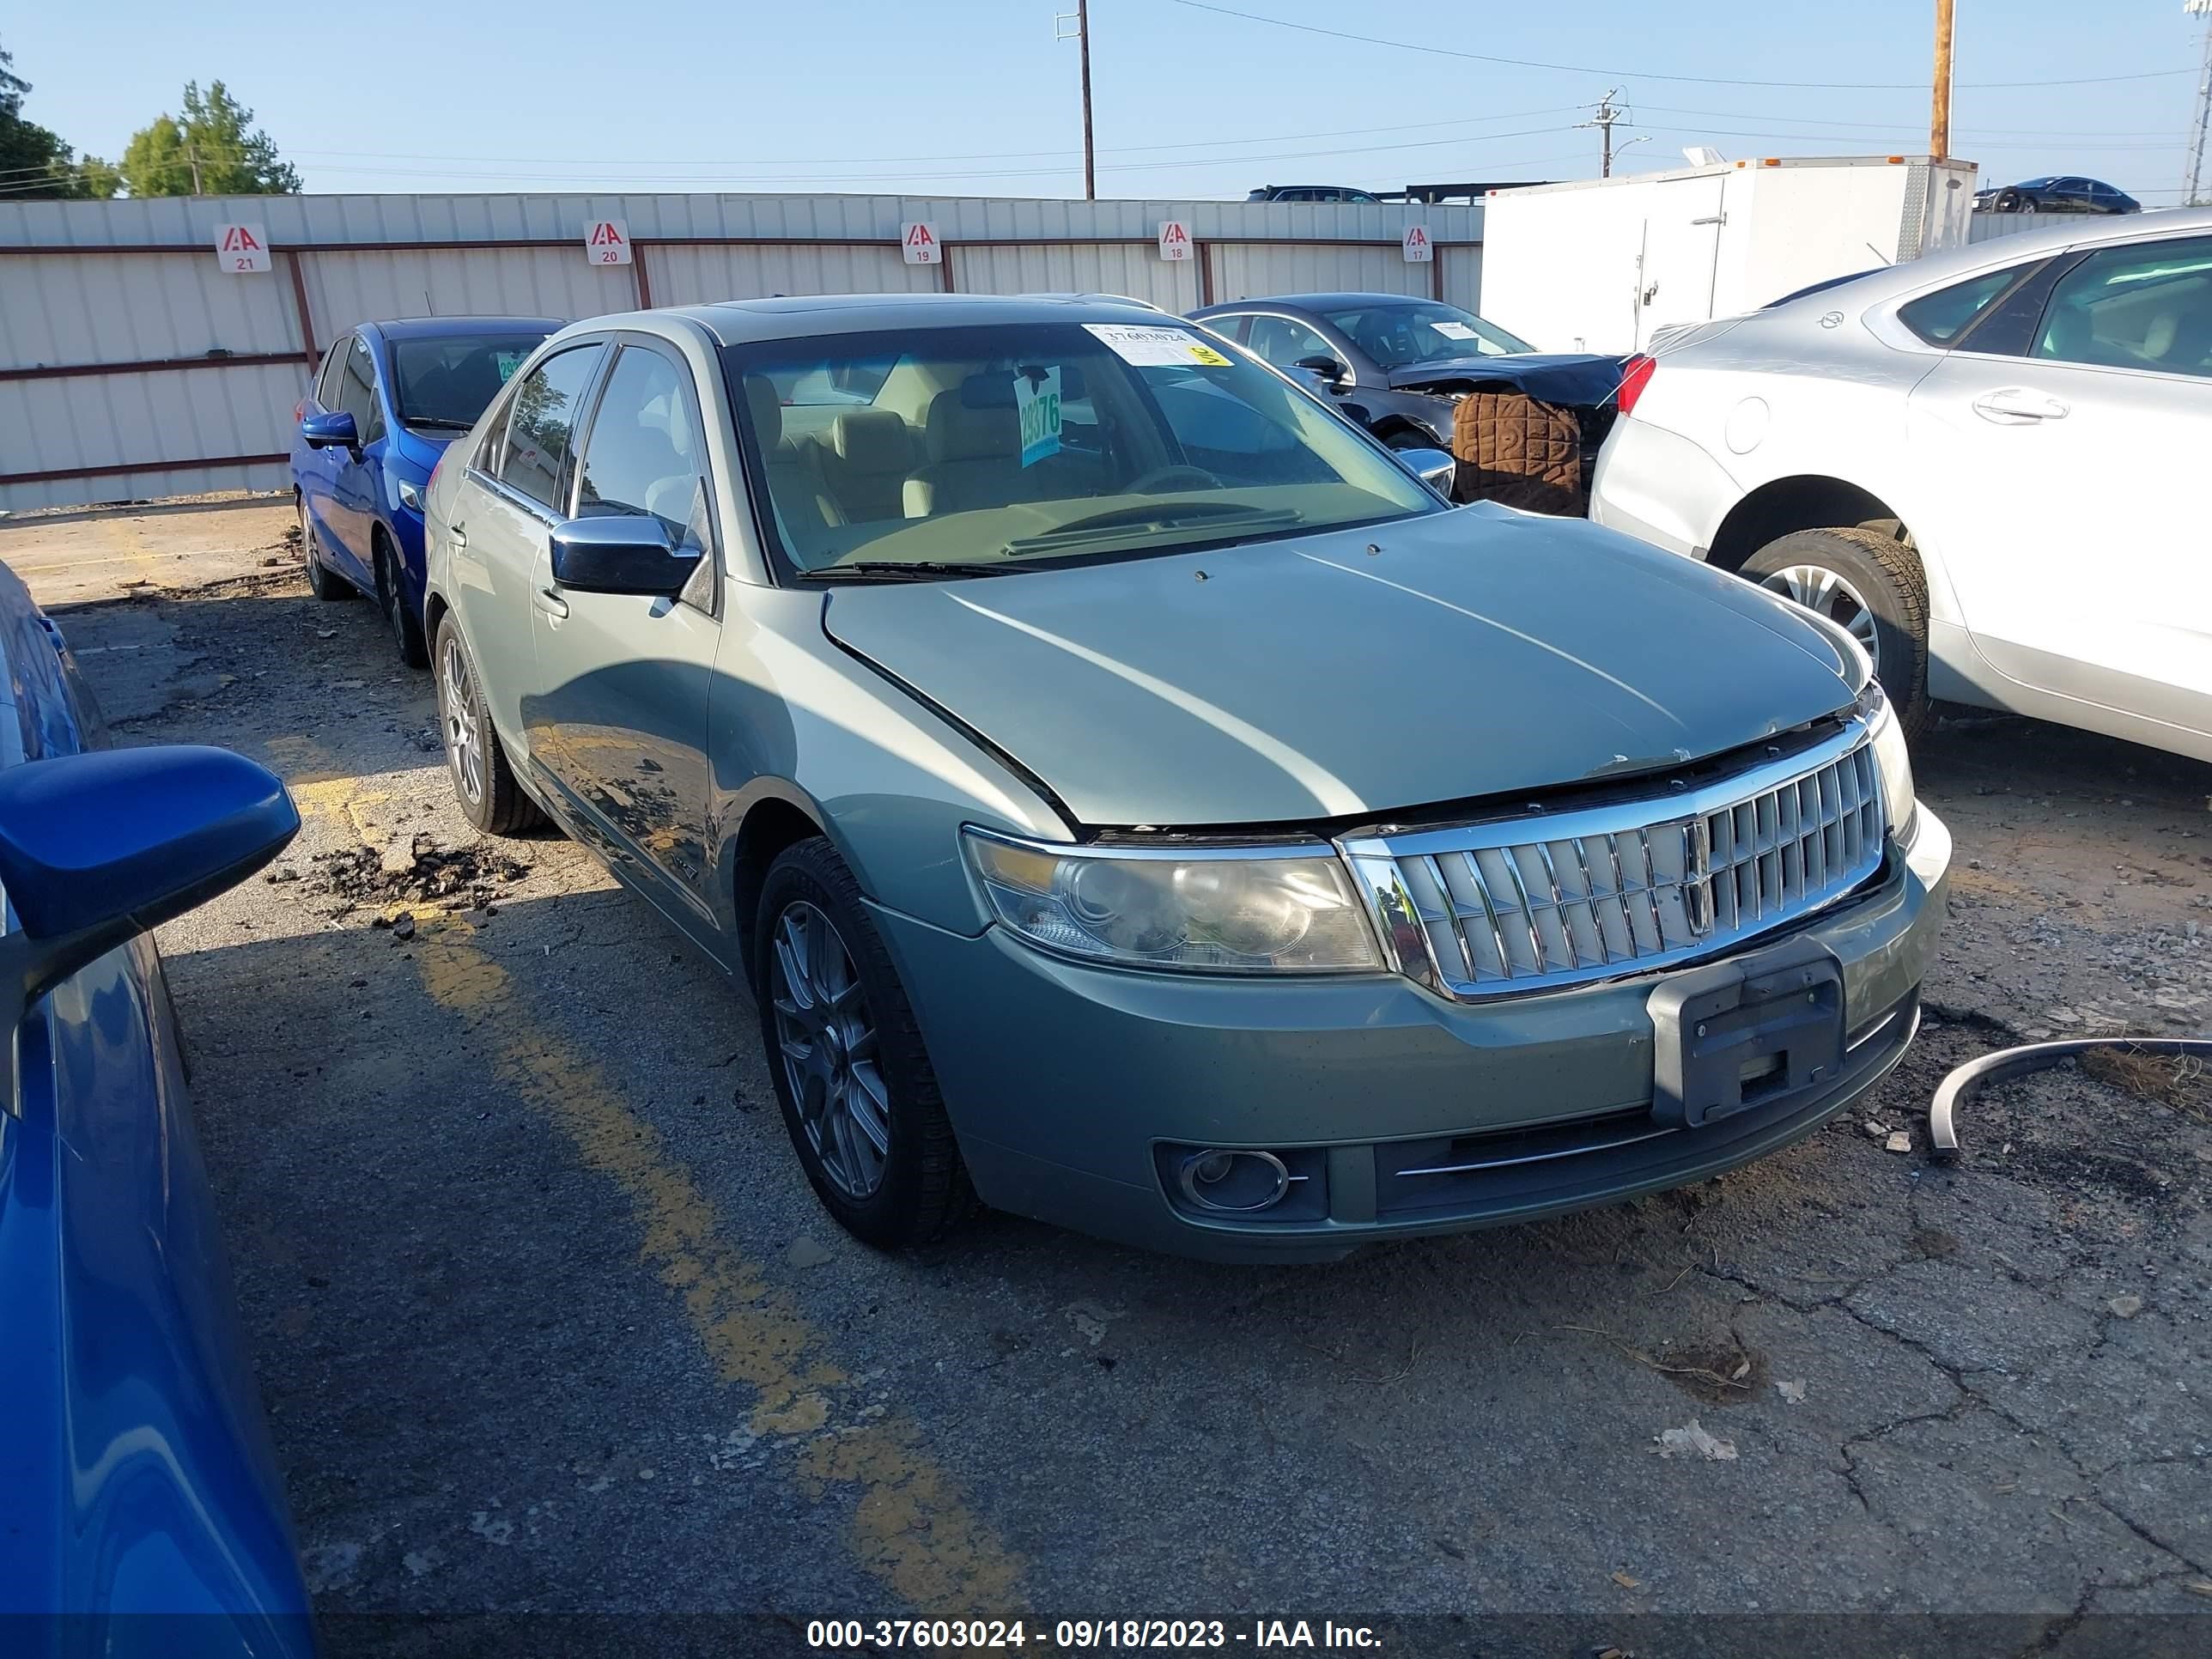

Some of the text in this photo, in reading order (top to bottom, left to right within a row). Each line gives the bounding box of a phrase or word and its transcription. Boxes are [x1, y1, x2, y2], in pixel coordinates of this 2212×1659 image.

[602, 251, 617, 262] 20
[916, 251, 930, 262] 19
[1170, 248, 1182, 258] 18
[1413, 251, 1423, 260] 17
[236, 258, 254, 270] 21
[1104, 332, 1188, 342] 37603024
[1022, 393, 1060, 447] 29376
